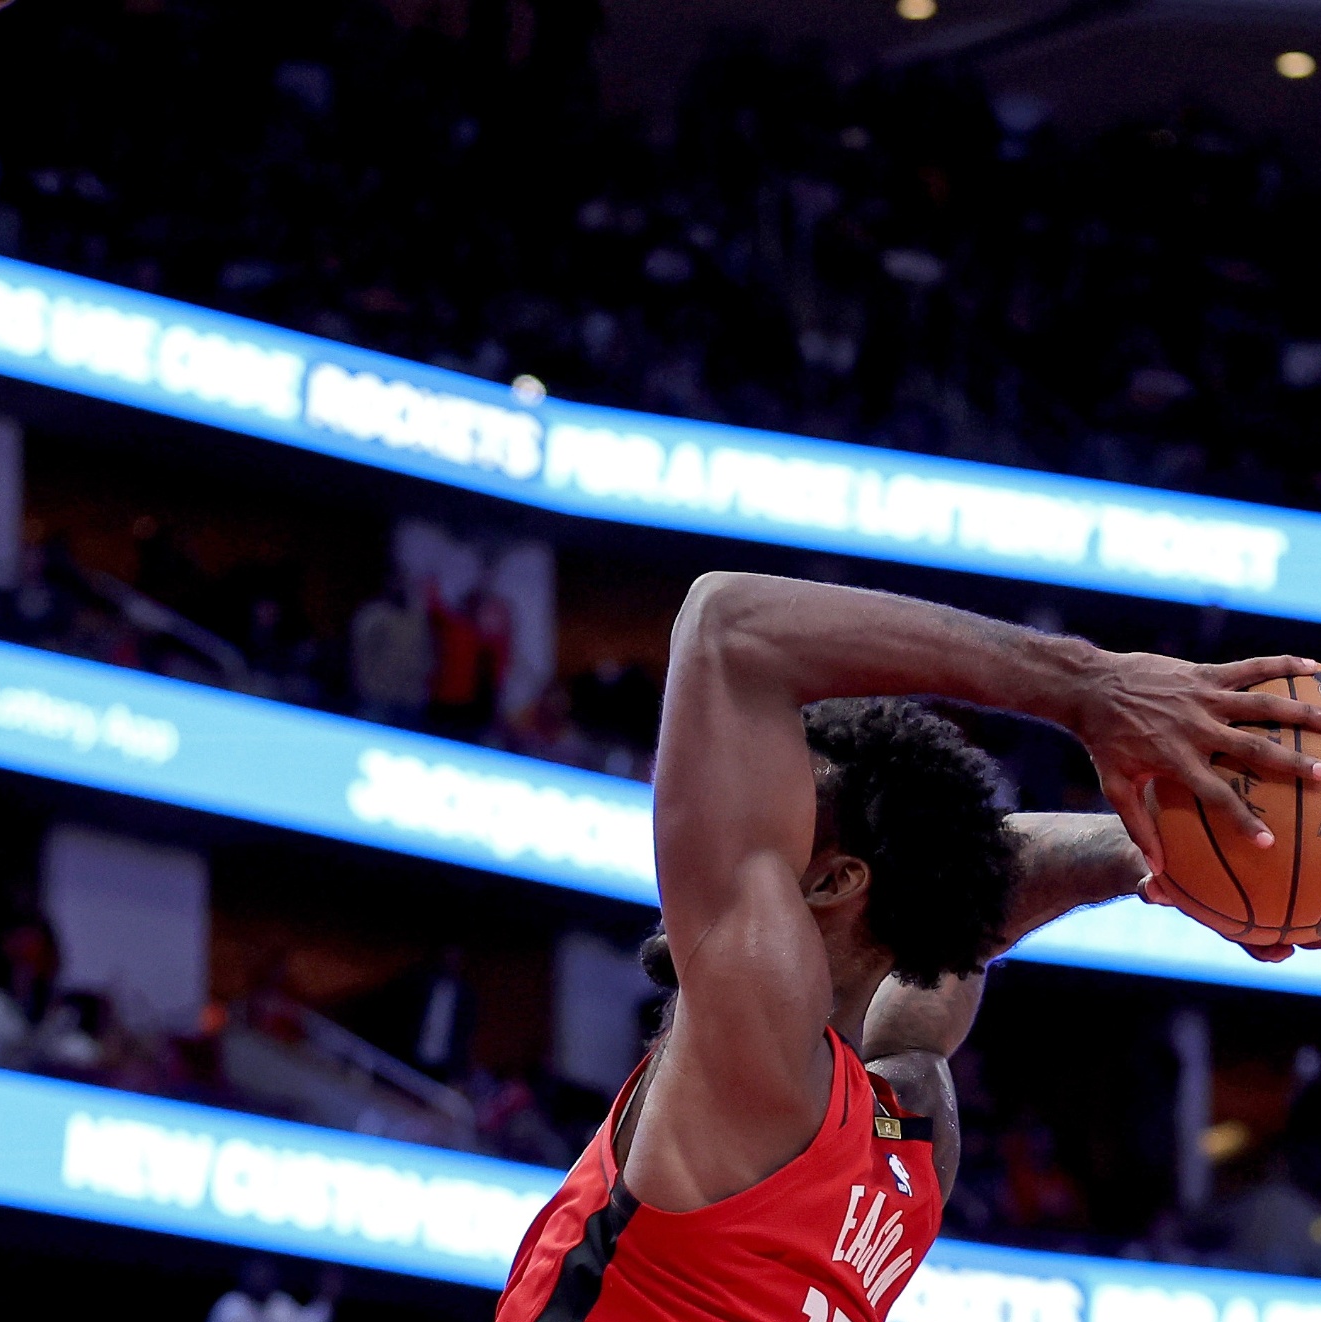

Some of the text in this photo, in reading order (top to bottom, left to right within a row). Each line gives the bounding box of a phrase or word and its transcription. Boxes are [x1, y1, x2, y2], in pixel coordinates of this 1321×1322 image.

[306, 362, 543, 480] ROCKETS
[1098, 502, 1289, 592] TICKET
[832, 1185, 912, 1307] EASON
